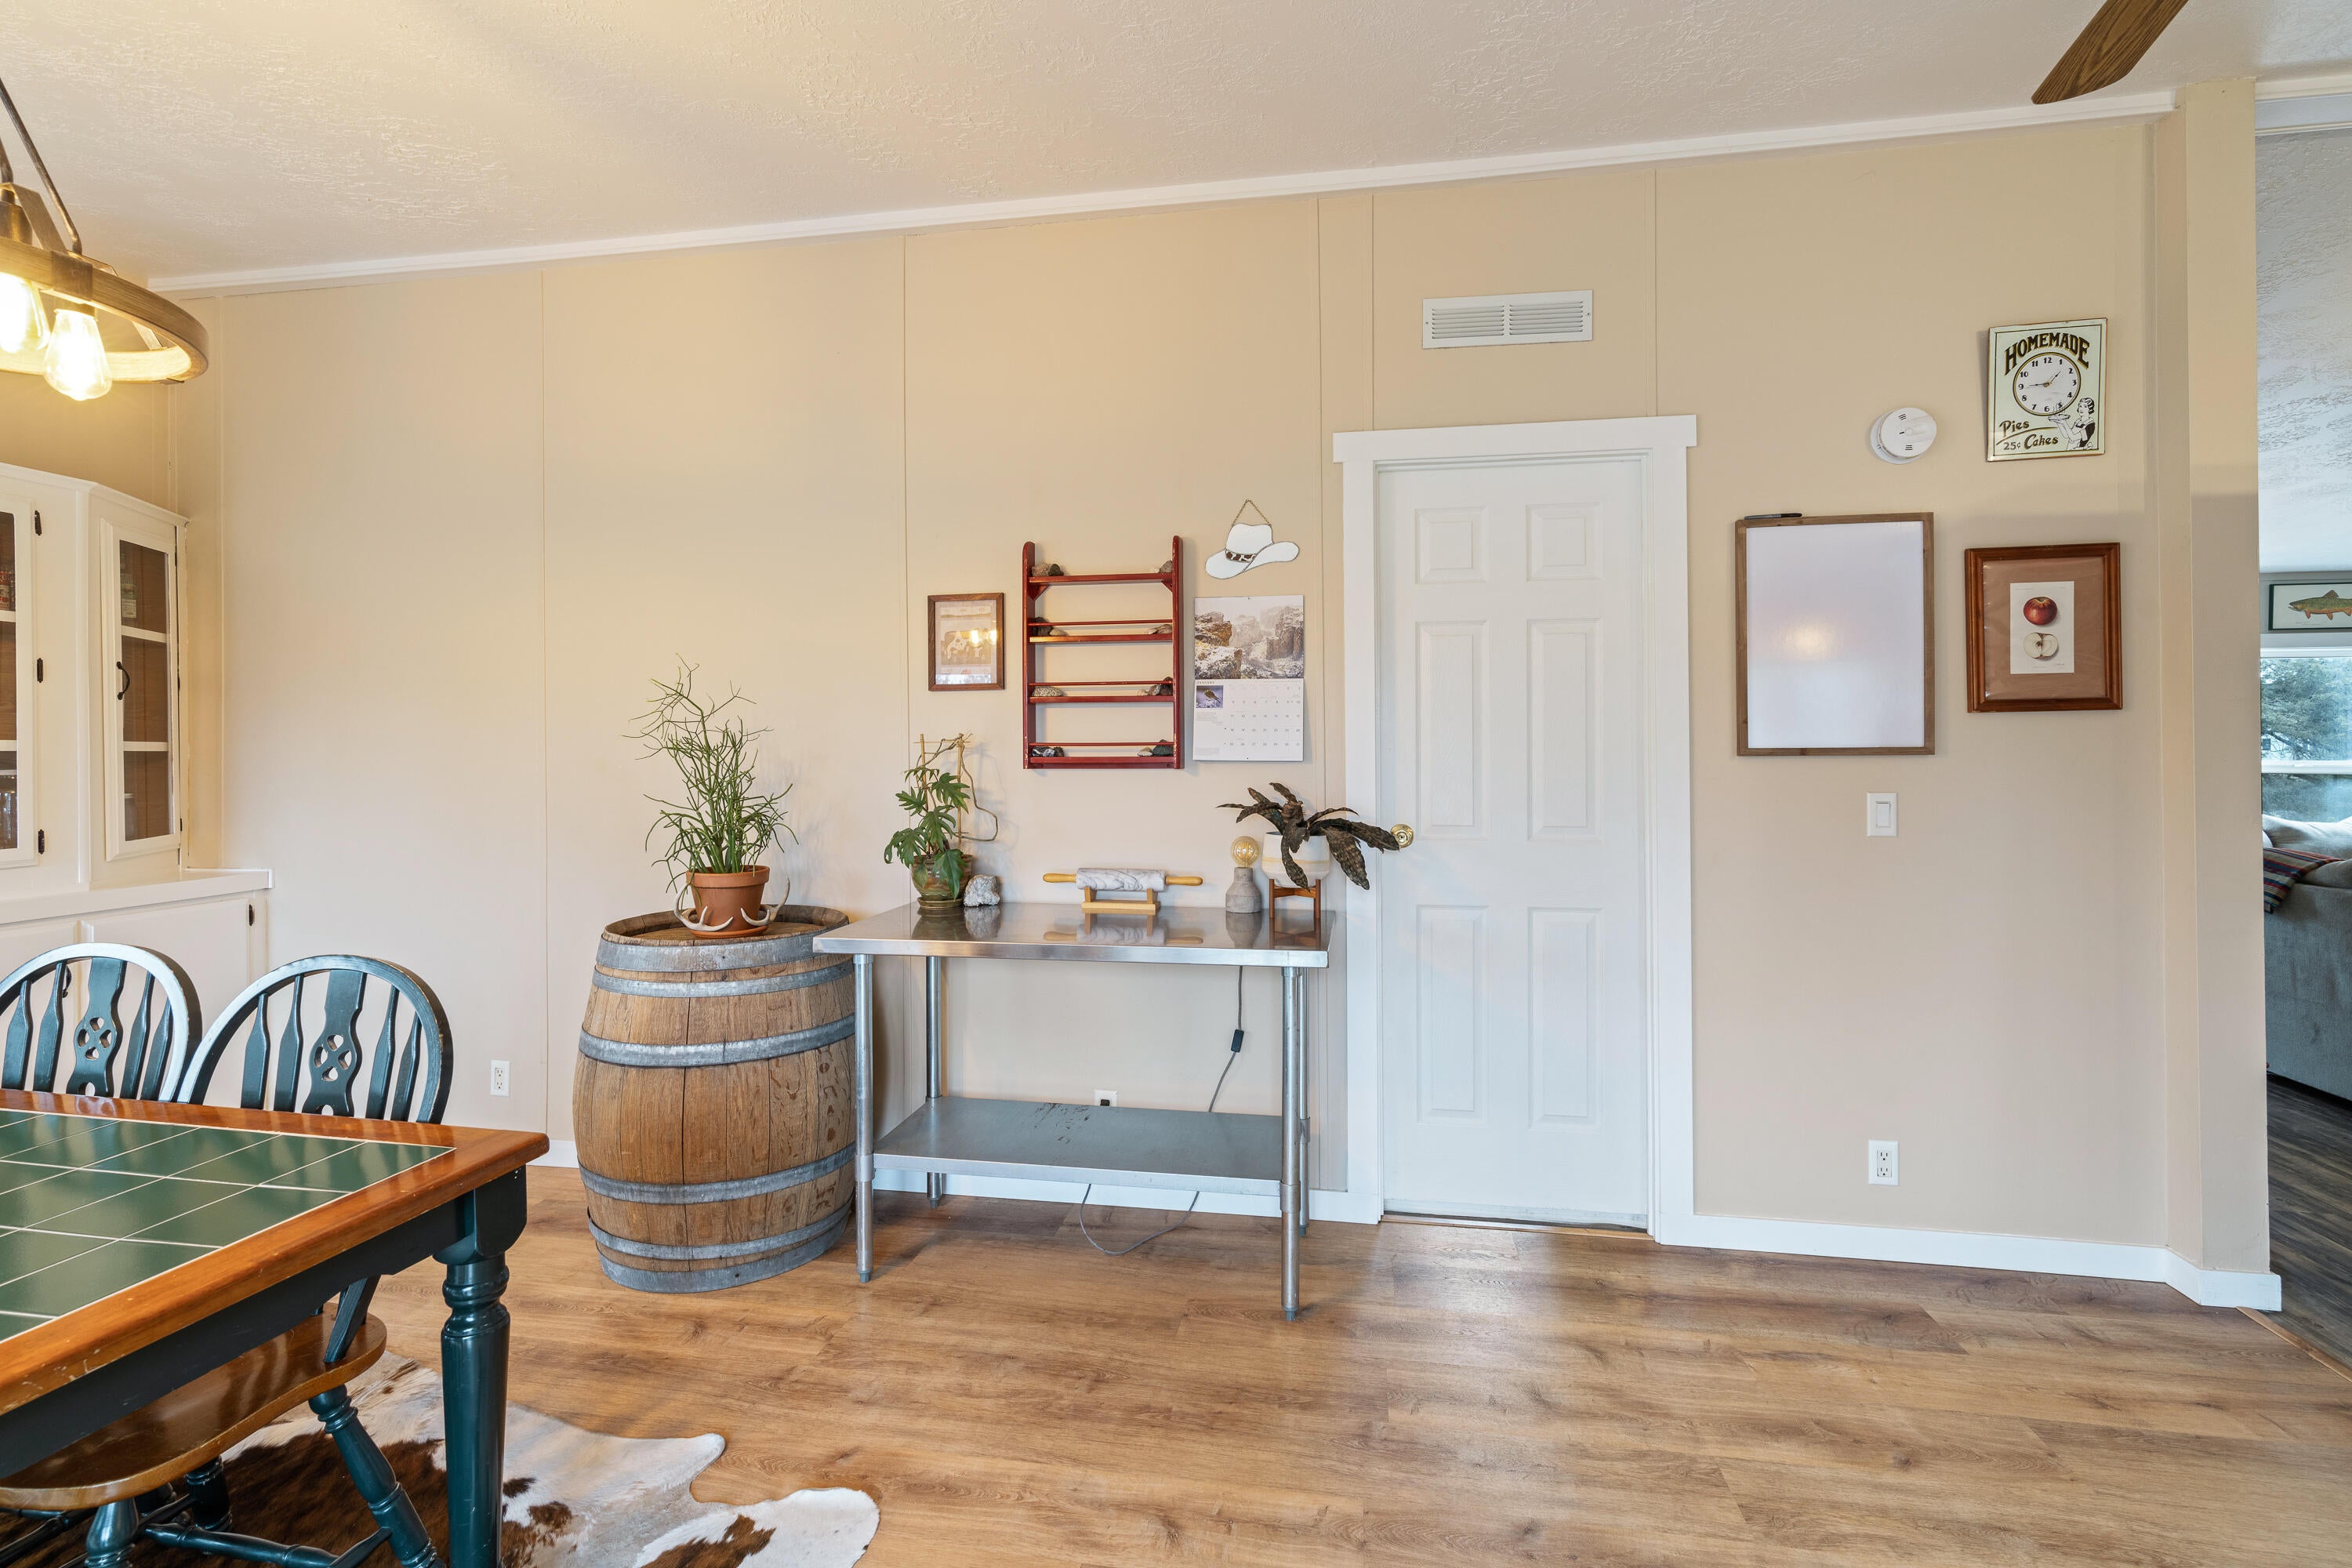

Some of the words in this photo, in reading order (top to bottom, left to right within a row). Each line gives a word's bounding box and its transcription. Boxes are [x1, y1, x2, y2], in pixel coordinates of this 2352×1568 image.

[2004, 332, 2090, 376] HOMEMADE
[1999, 420, 2030, 437] Pies
[2003, 441, 2021, 451] 25¢
[2024, 434, 2059, 450] Cakes
